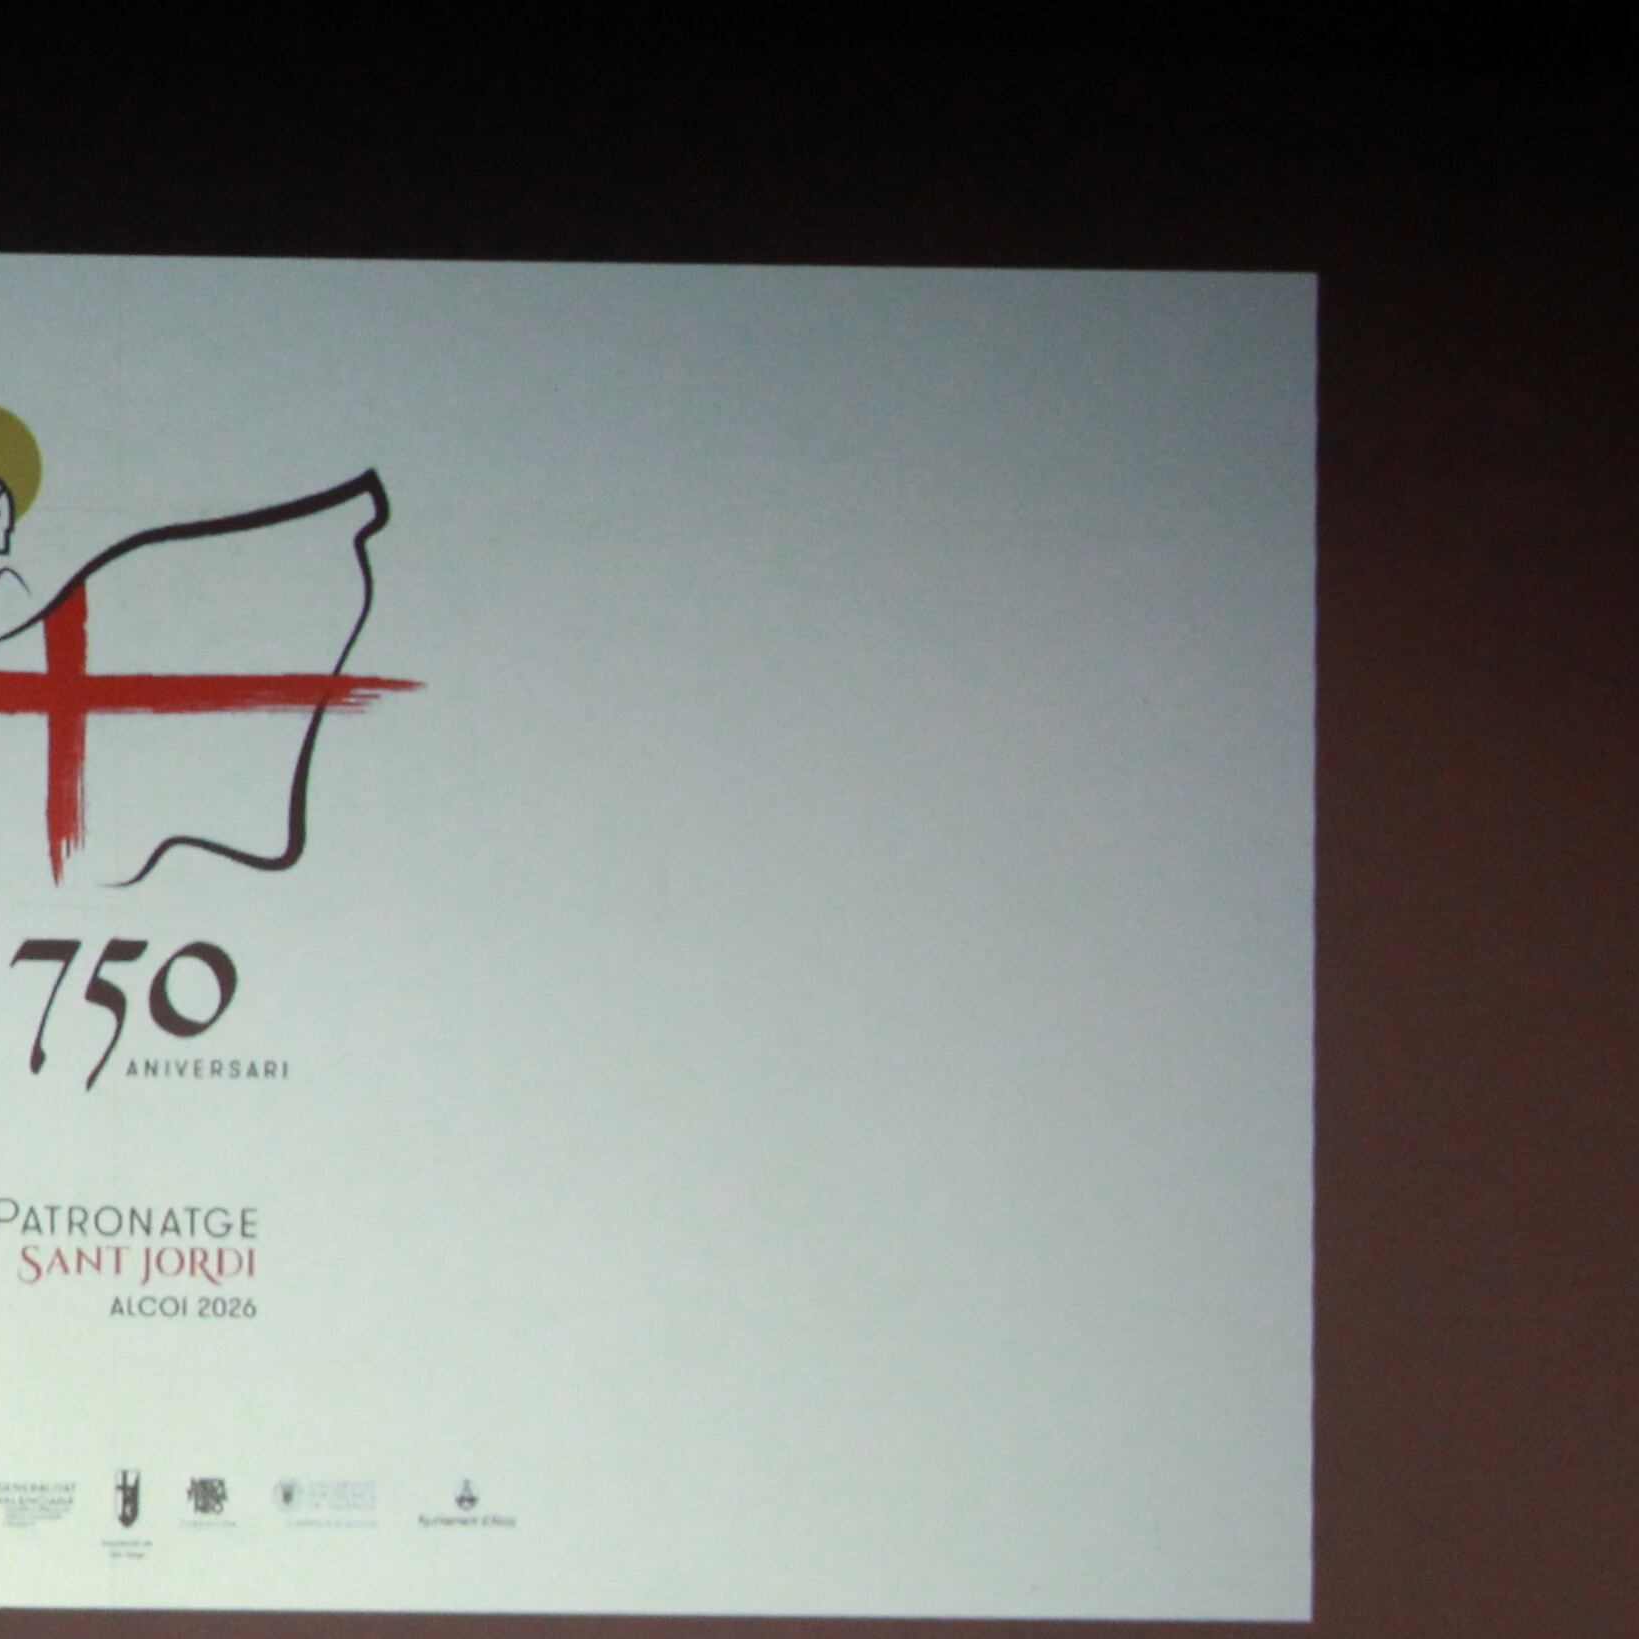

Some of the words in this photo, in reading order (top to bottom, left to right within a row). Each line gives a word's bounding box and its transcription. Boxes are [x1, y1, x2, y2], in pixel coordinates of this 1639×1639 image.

[10, 938, 238, 1092] 750
[126, 1060, 289, 1080] ANIVERSARI
[18, 1245, 131, 1284] SANT
[141, 1246, 256, 1286] JORDI
[110, 1297, 188, 1317] ALCOI
[197, 1297, 258, 1318] 2026
